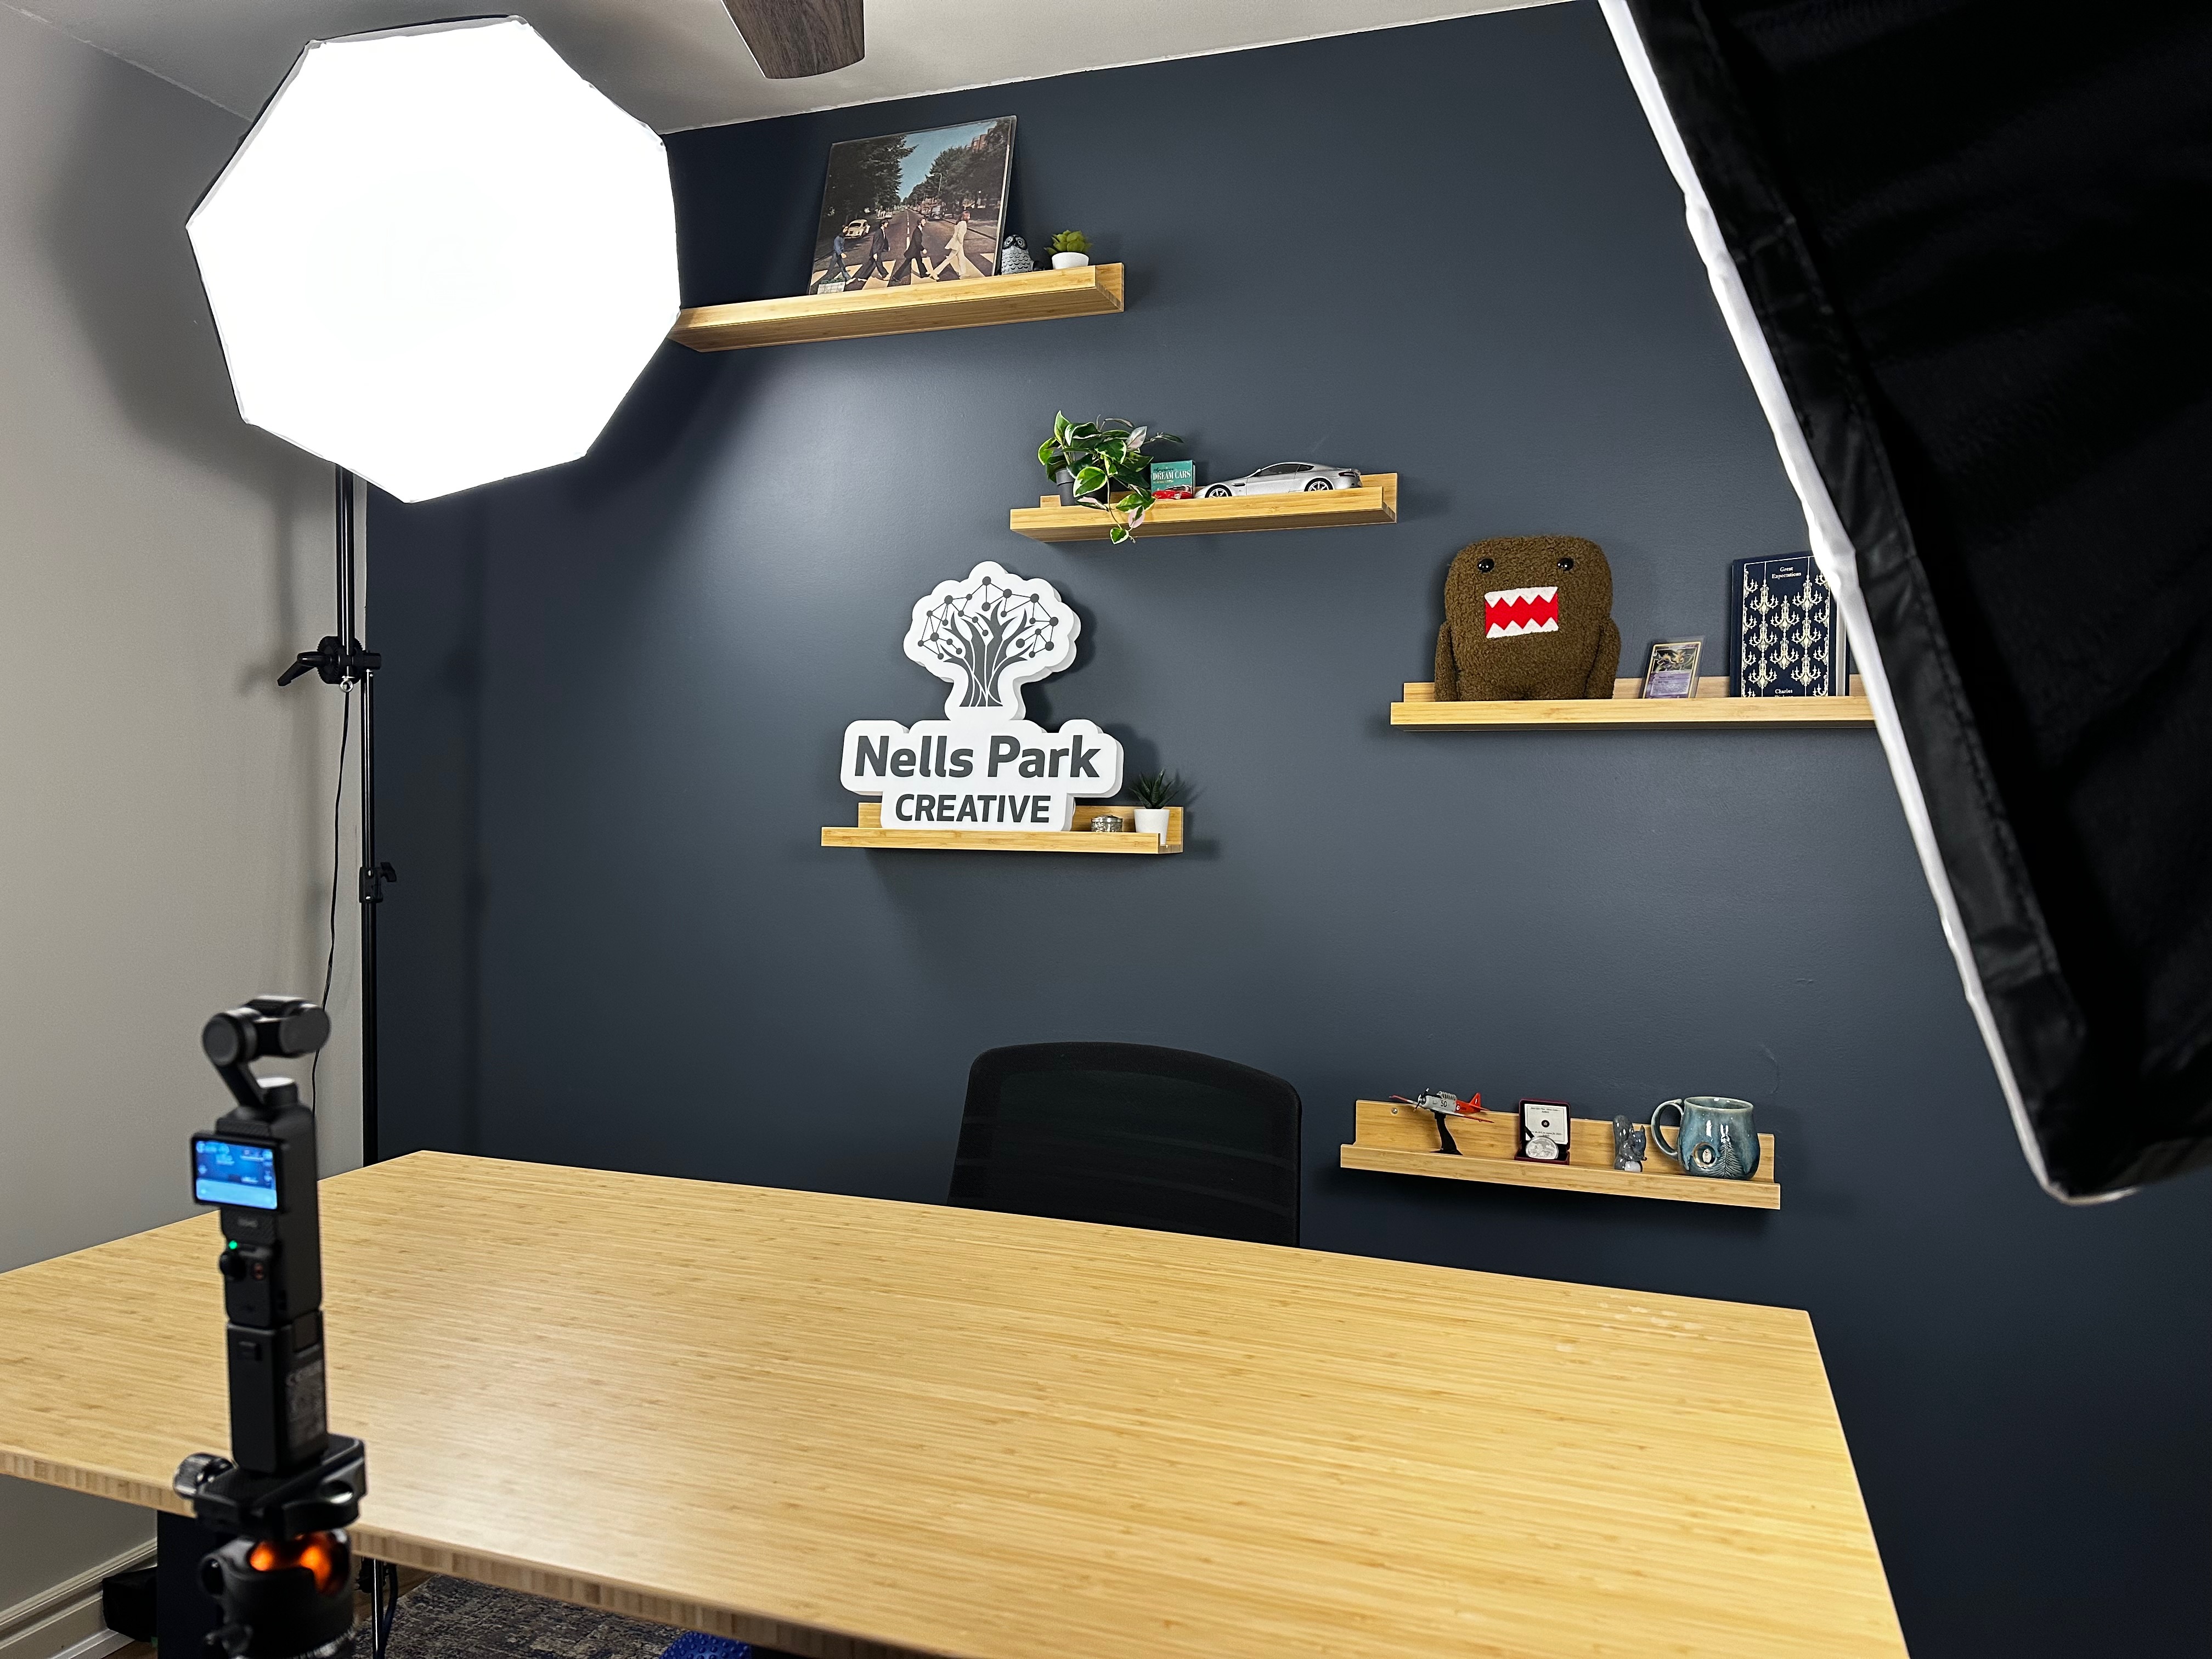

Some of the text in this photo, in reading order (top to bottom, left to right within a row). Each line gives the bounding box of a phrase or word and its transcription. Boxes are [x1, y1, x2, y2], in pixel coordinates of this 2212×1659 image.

[1153, 470, 1191, 481] DREAM CARS
[855, 735, 1102, 778] Nells Park
[895, 794, 1051, 823] CREATIVE
